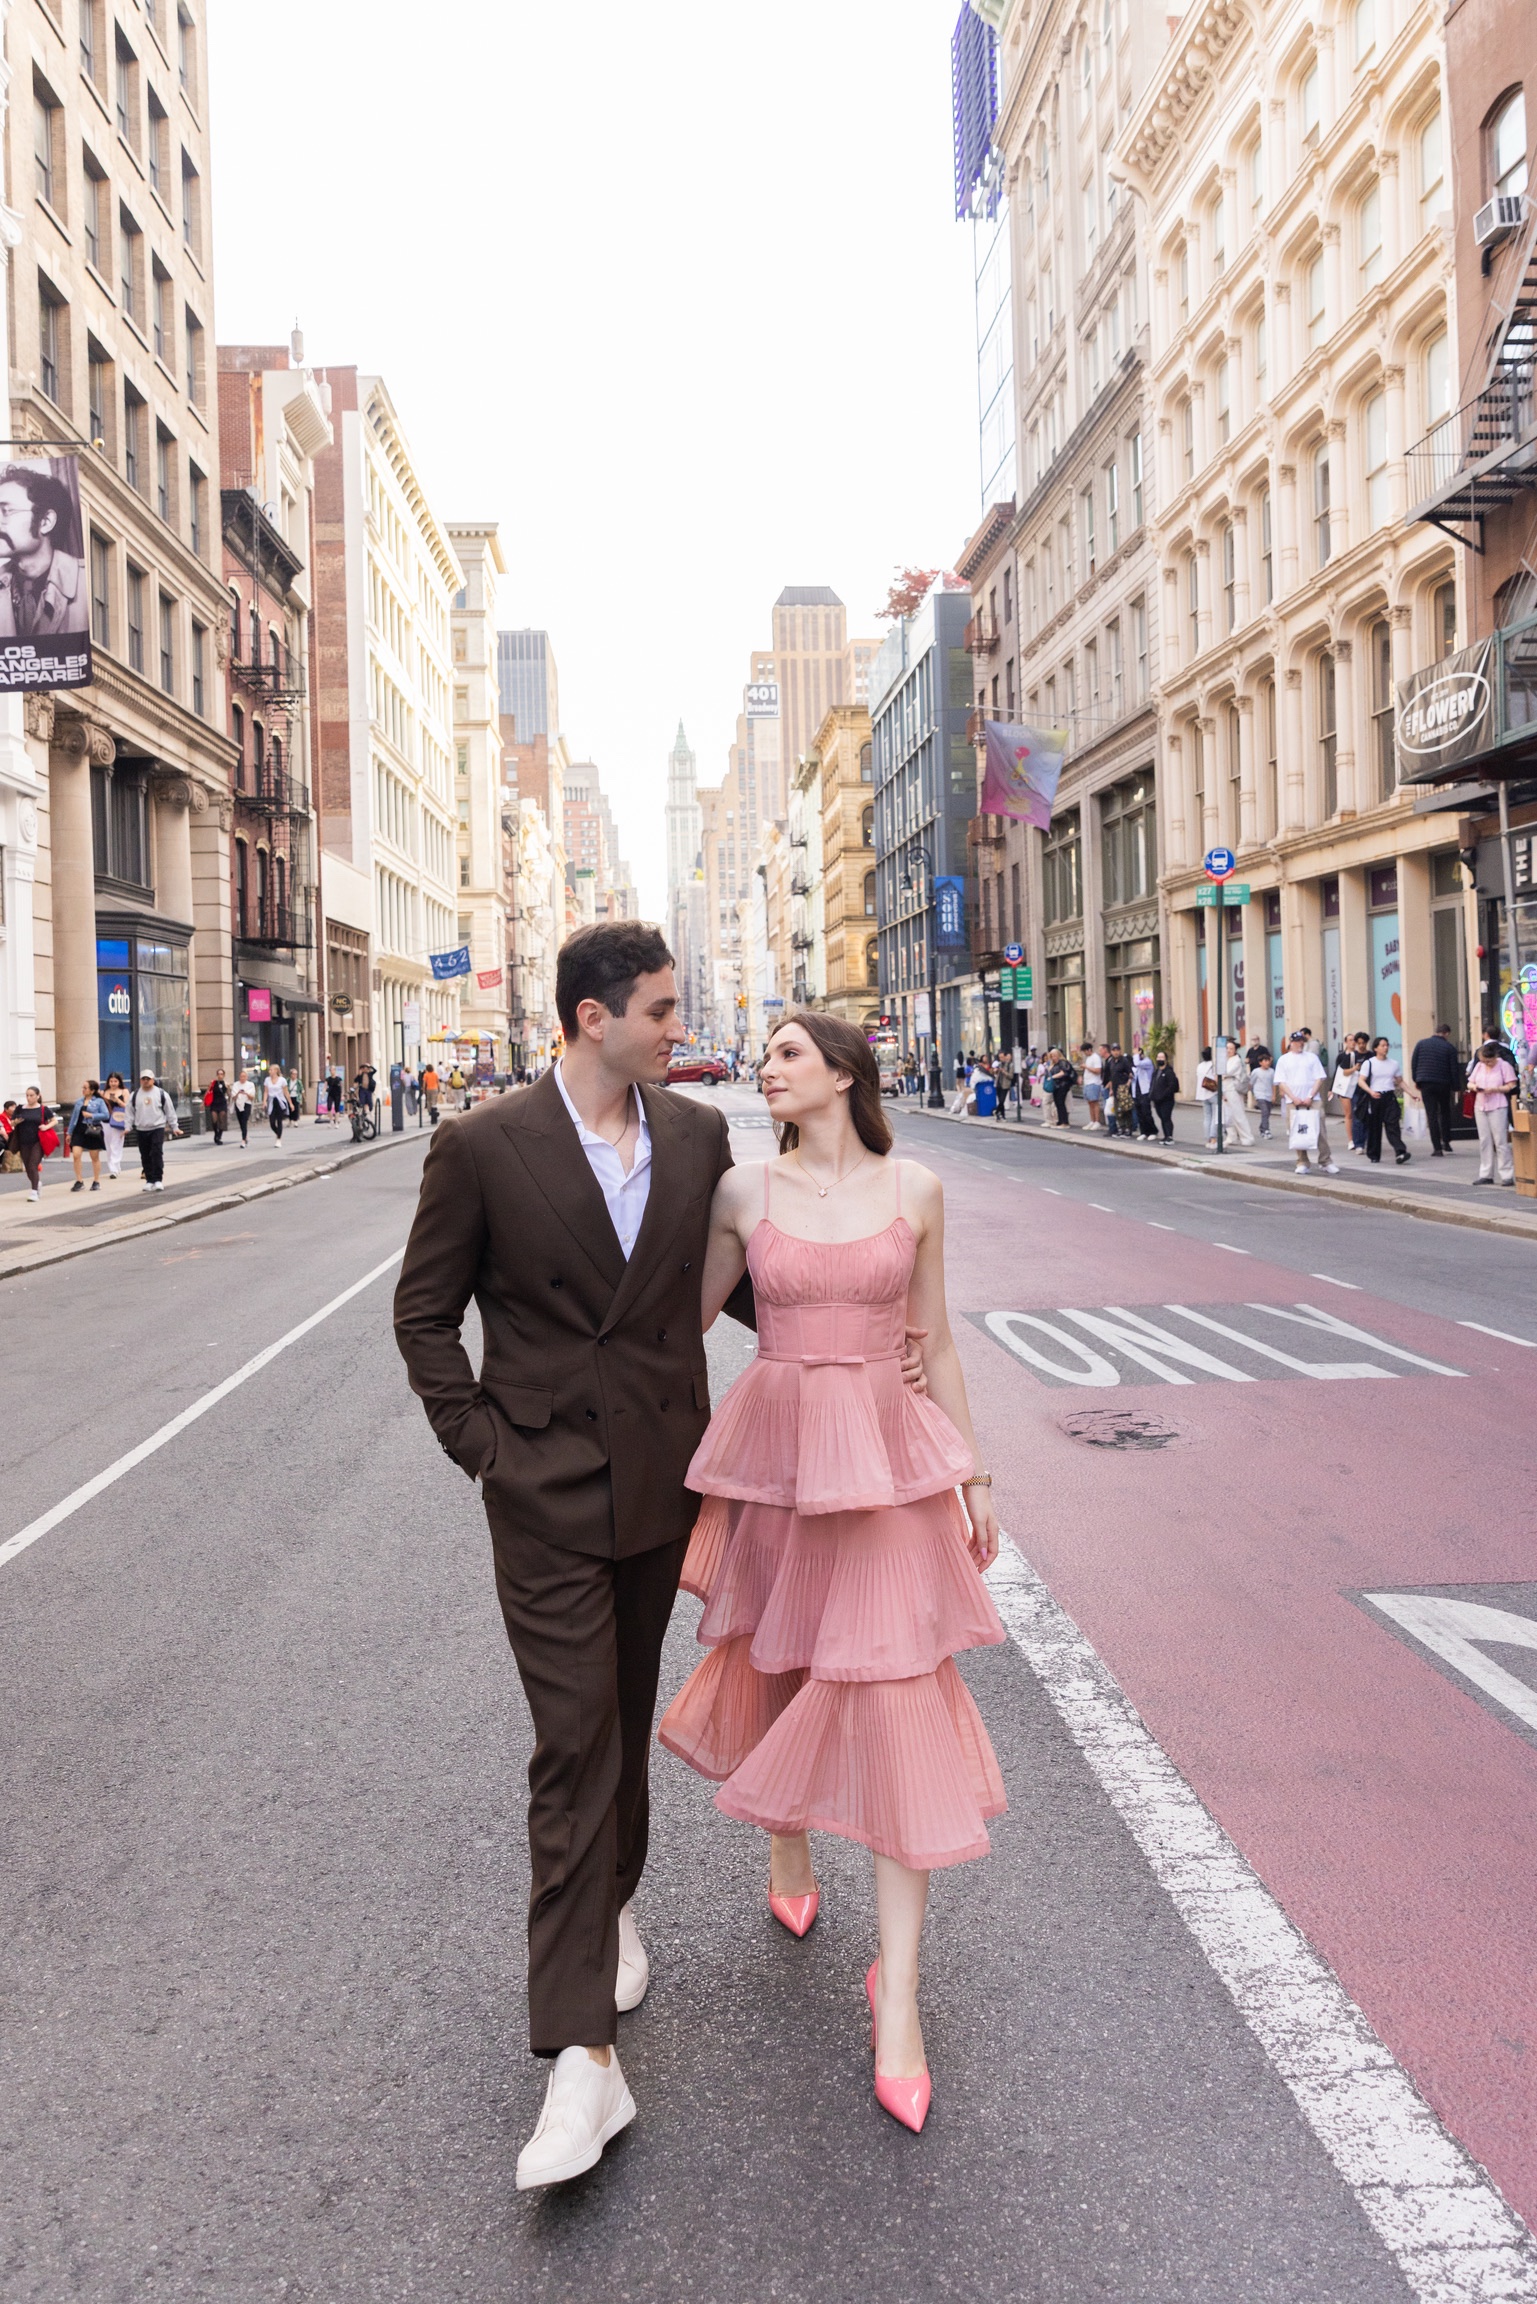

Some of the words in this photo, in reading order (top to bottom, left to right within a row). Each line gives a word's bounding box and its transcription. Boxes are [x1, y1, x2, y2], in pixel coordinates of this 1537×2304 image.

[748, 686, 777, 701] 401
[1411, 686, 1476, 736] FLOWERY
[1420, 722, 1449, 744] CANNABIS
[1515, 838, 1529, 888] THE
[434, 949, 468, 969] 462
[985, 1303, 1470, 1388] ONLY
